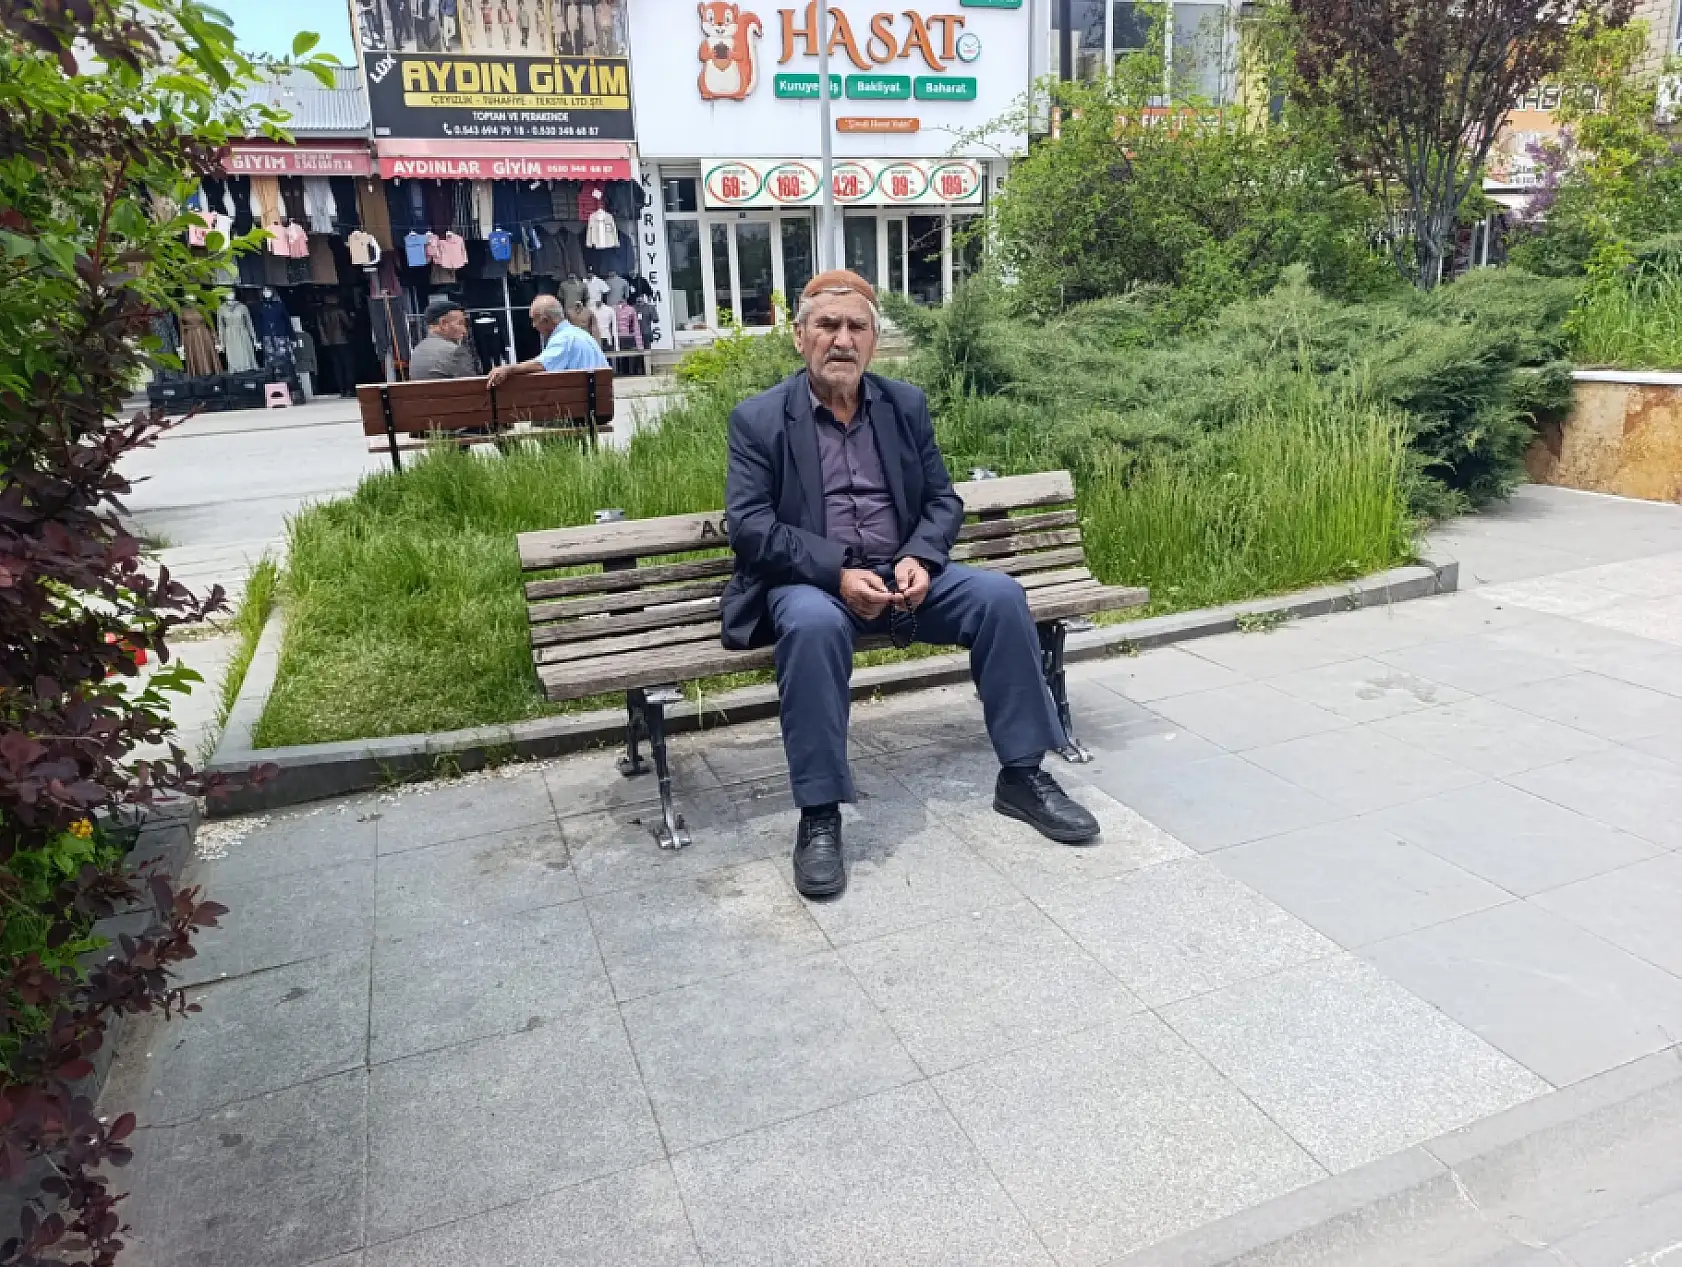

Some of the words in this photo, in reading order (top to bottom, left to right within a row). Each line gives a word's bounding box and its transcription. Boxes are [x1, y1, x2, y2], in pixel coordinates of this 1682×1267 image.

[776, 0, 966, 72] HASAT
[401, 60, 517, 93] AYDIN
[529, 58, 627, 95] GİYİM
[778, 80, 839, 94] Kuruyeiş
[857, 80, 900, 94] Bakliyat
[925, 82, 967, 93] Baharat
[472, 110, 506, 121] TOPTAN
[521, 112, 569, 122] PERAKENDE
[393, 159, 481, 174] AYDINLAR
[493, 158, 542, 175] GİYİM
[641, 173, 662, 342] KURUYEMŞ
